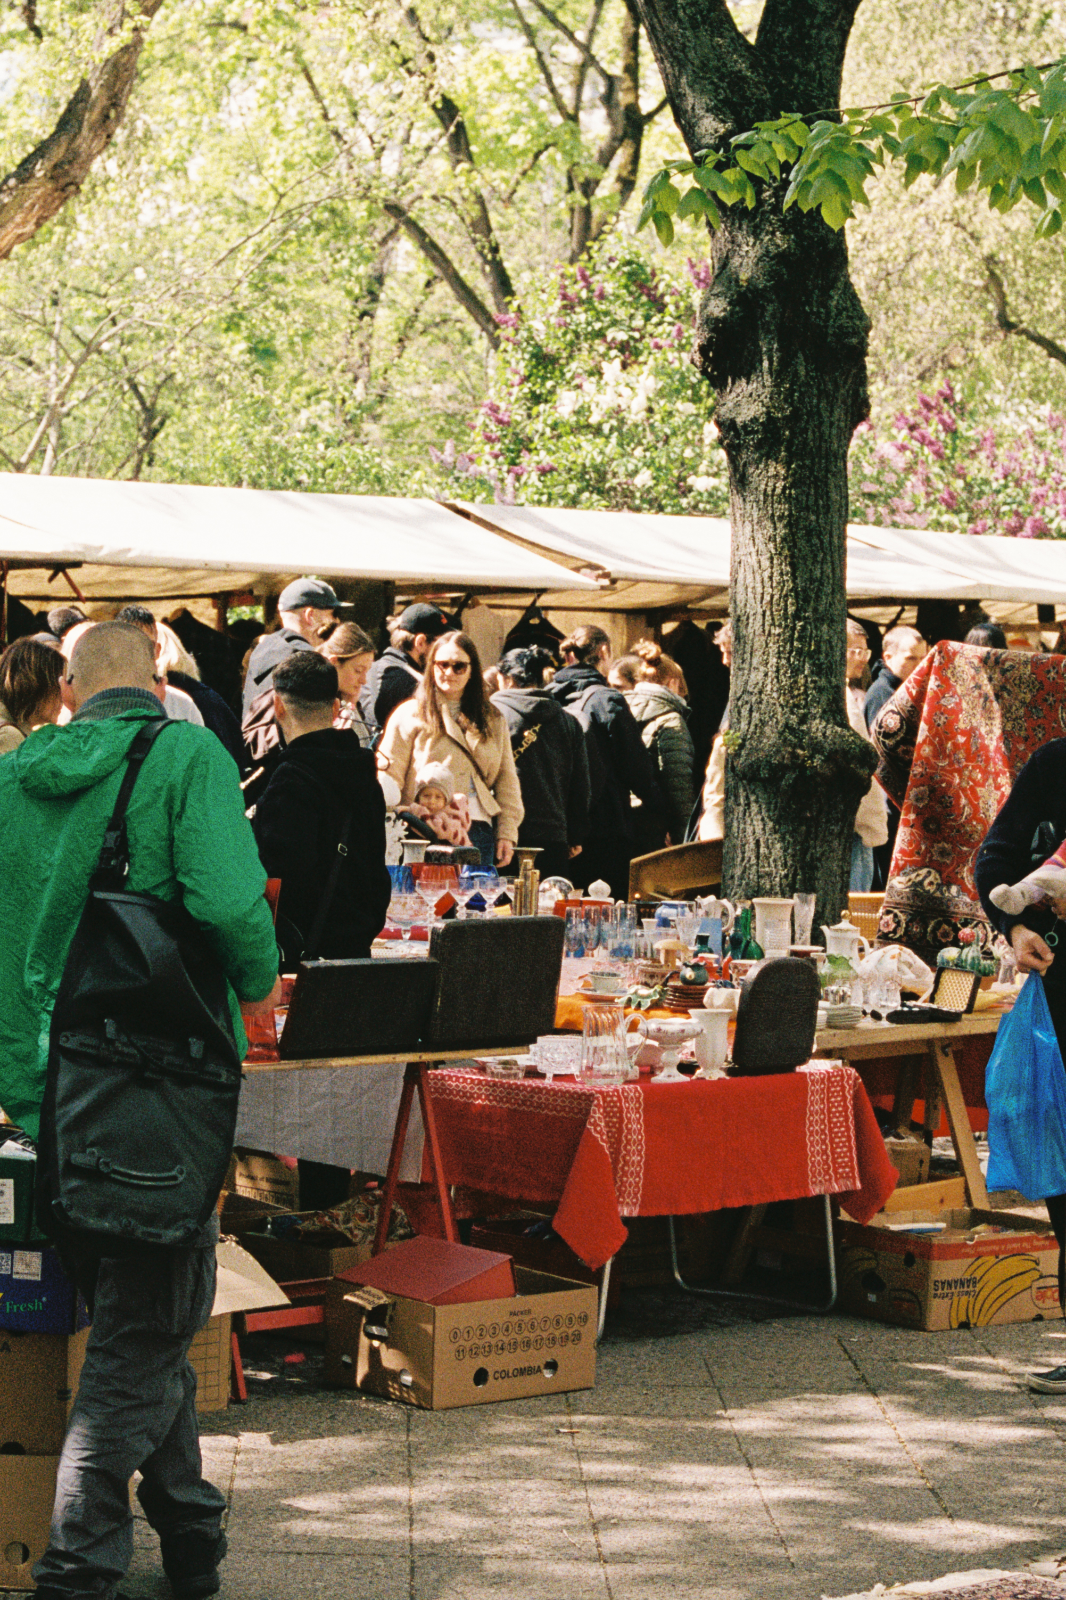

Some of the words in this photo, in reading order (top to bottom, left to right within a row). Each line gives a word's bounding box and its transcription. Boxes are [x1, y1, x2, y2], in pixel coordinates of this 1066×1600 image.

[933, 1276, 977, 1291] BANANAS
[5, 1299, 43, 1314] Fresh
[493, 1365, 542, 1380] COLOMBIA
